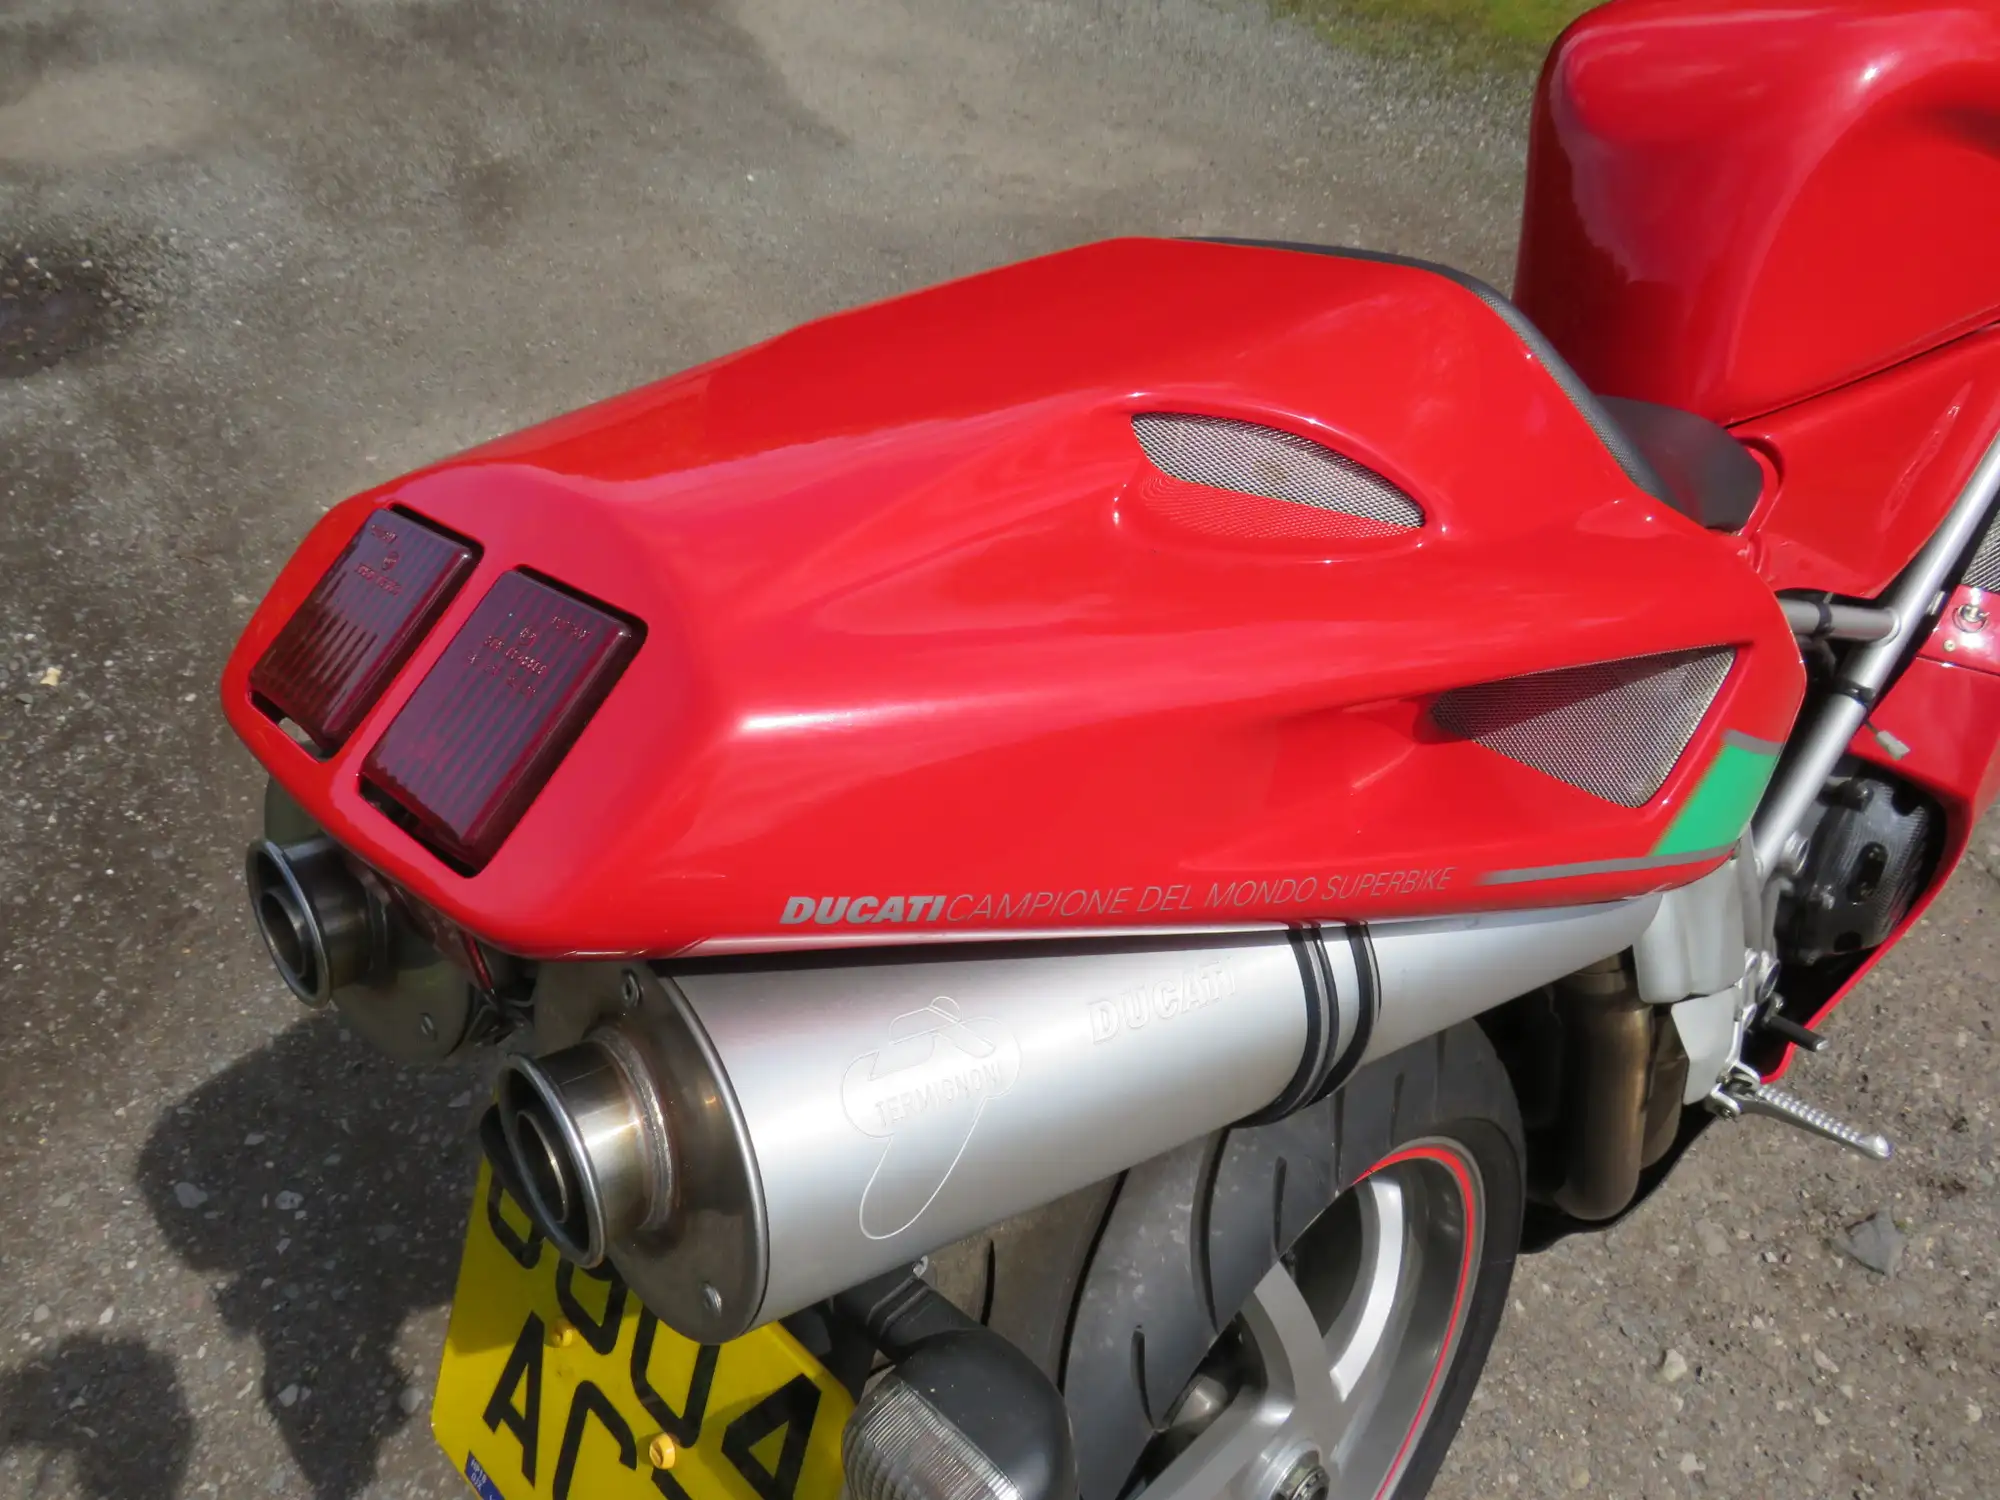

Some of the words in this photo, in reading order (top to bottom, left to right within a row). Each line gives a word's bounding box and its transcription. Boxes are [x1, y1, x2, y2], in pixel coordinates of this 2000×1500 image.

[779, 895, 947, 925] DUCATI
[946, 887, 1133, 923] CAMPIONE
[1136, 884, 1192, 912] DEL
[1204, 877, 1317, 908] MONDO
[1321, 867, 1456, 901] SUPERBIKE
[1087, 956, 1236, 1045] DUCATI
